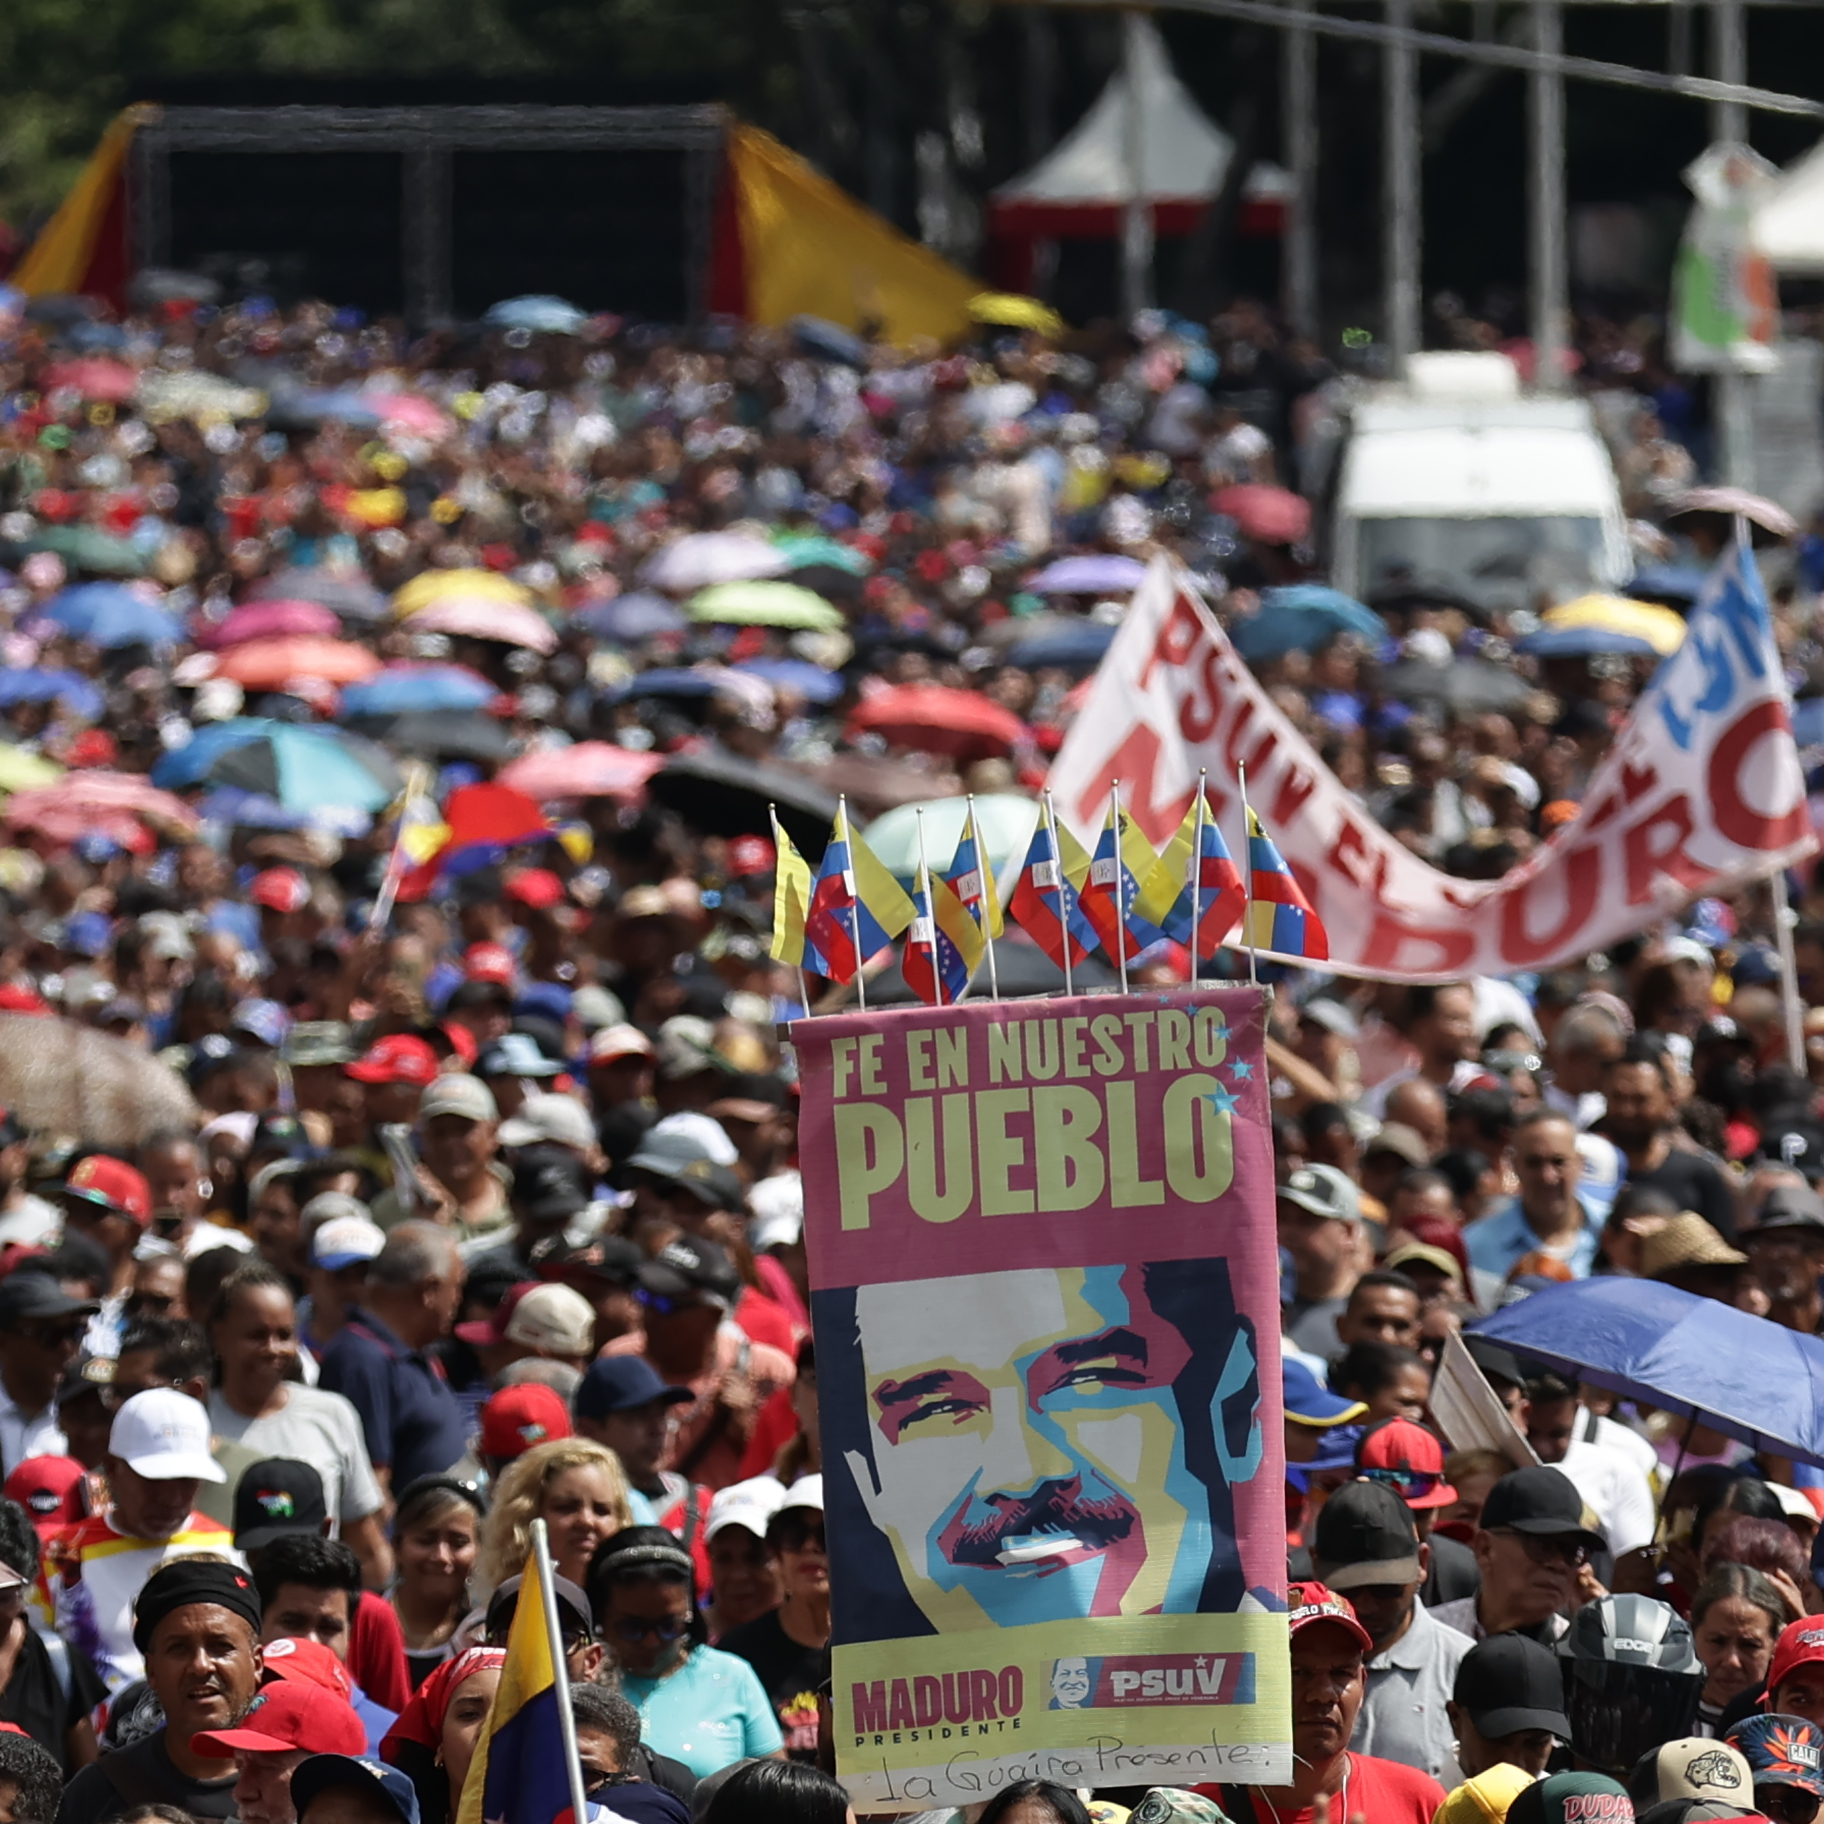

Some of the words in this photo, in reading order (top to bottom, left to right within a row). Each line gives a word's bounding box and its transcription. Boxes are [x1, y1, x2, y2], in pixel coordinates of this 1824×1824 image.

[832, 1035, 888, 1097] FE
[908, 1025, 969, 1090] EN
[988, 1006, 1228, 1083] NUESTRO
[832, 1072, 1235, 1231] PUEBLO
[1614, 1637, 1654, 1655] EDGE
[852, 1665, 1024, 1734] MADURO
[1109, 1656, 1227, 1699] PSUV
[855, 1720, 1022, 1748] PRESIDENTE
[875, 1756, 938, 1801] La
